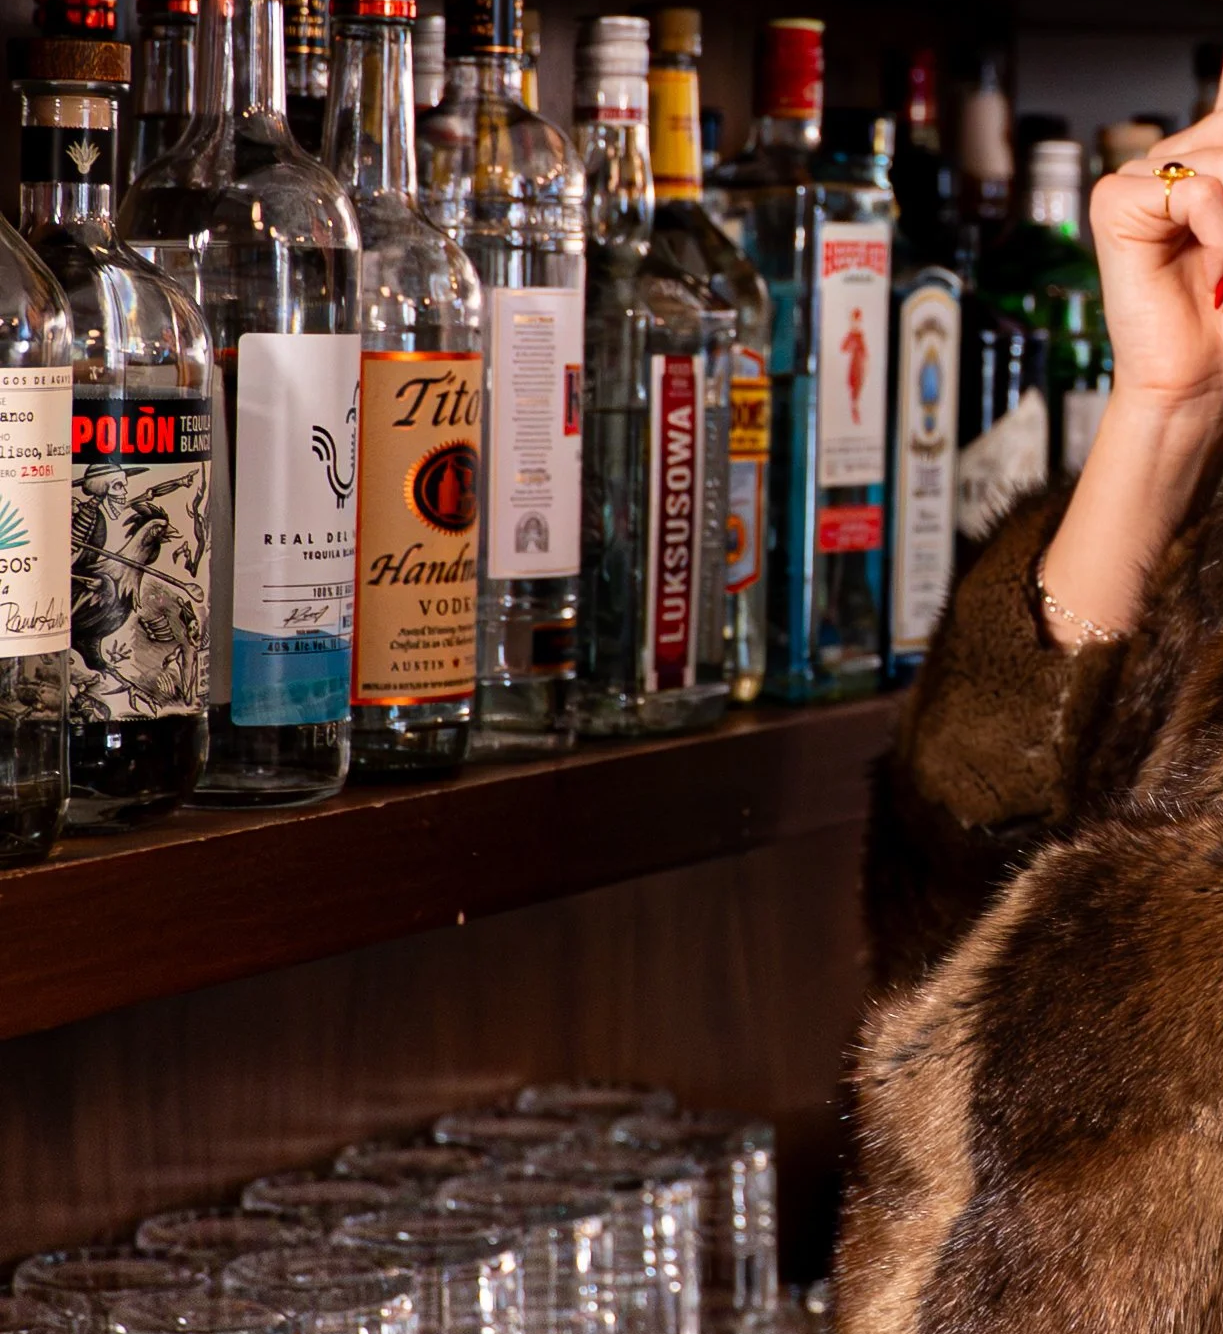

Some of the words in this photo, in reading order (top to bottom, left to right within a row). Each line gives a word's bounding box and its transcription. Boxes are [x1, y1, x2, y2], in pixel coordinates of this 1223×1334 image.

[2, 376, 27, 385] GOS
[34, 376, 46, 385] DE
[392, 369, 480, 427] Tito
[0, 411, 34, 422] anco
[72, 406, 175, 454] POLÒN
[0, 445, 42, 460] lisco,
[0, 468, 17, 478] ERO
[659, 404, 693, 644] LUKSUSOWA
[263, 532, 314, 545] REAL
[326, 530, 348, 544] DEL
[302, 550, 341, 561] TEQUILA
[366, 542, 476, 586] Handm
[418, 596, 473, 616] VODK
[267, 641, 290, 652] 40%
[390, 659, 444, 672] AUSTIN
